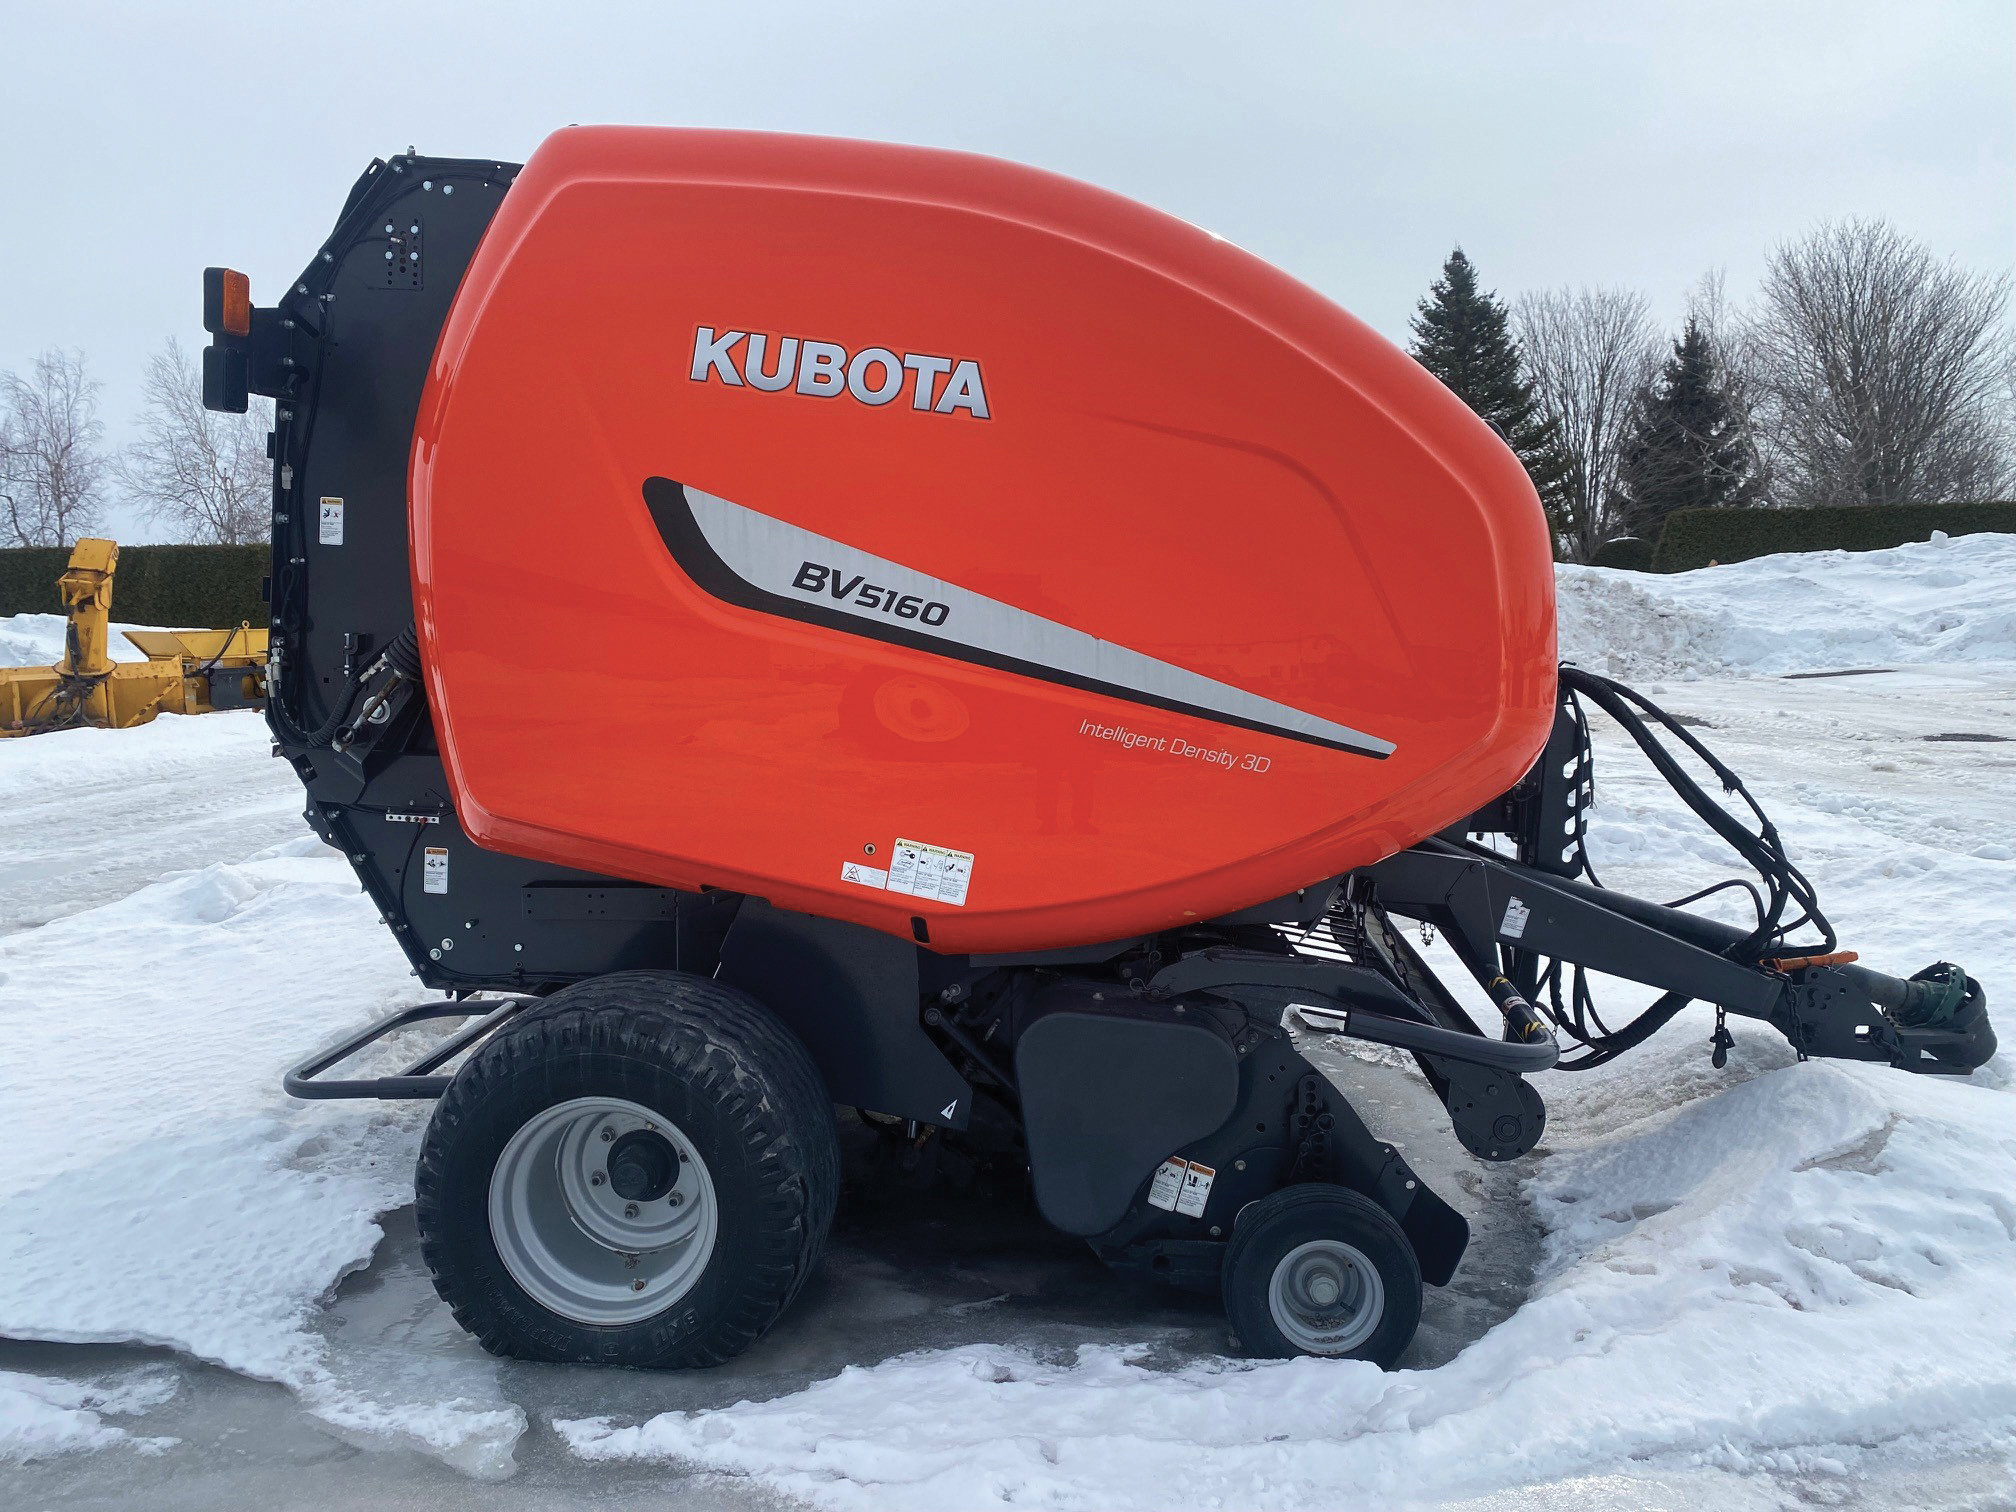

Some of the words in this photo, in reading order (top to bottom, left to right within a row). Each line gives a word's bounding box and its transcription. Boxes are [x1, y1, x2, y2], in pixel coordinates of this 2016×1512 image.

[690, 326, 990, 420] KUBOTA
[791, 561, 950, 626] BV5160
[1079, 719, 1167, 751] Intelligent
[1169, 738, 1239, 770] Density
[1240, 754, 1271, 773] 3D
